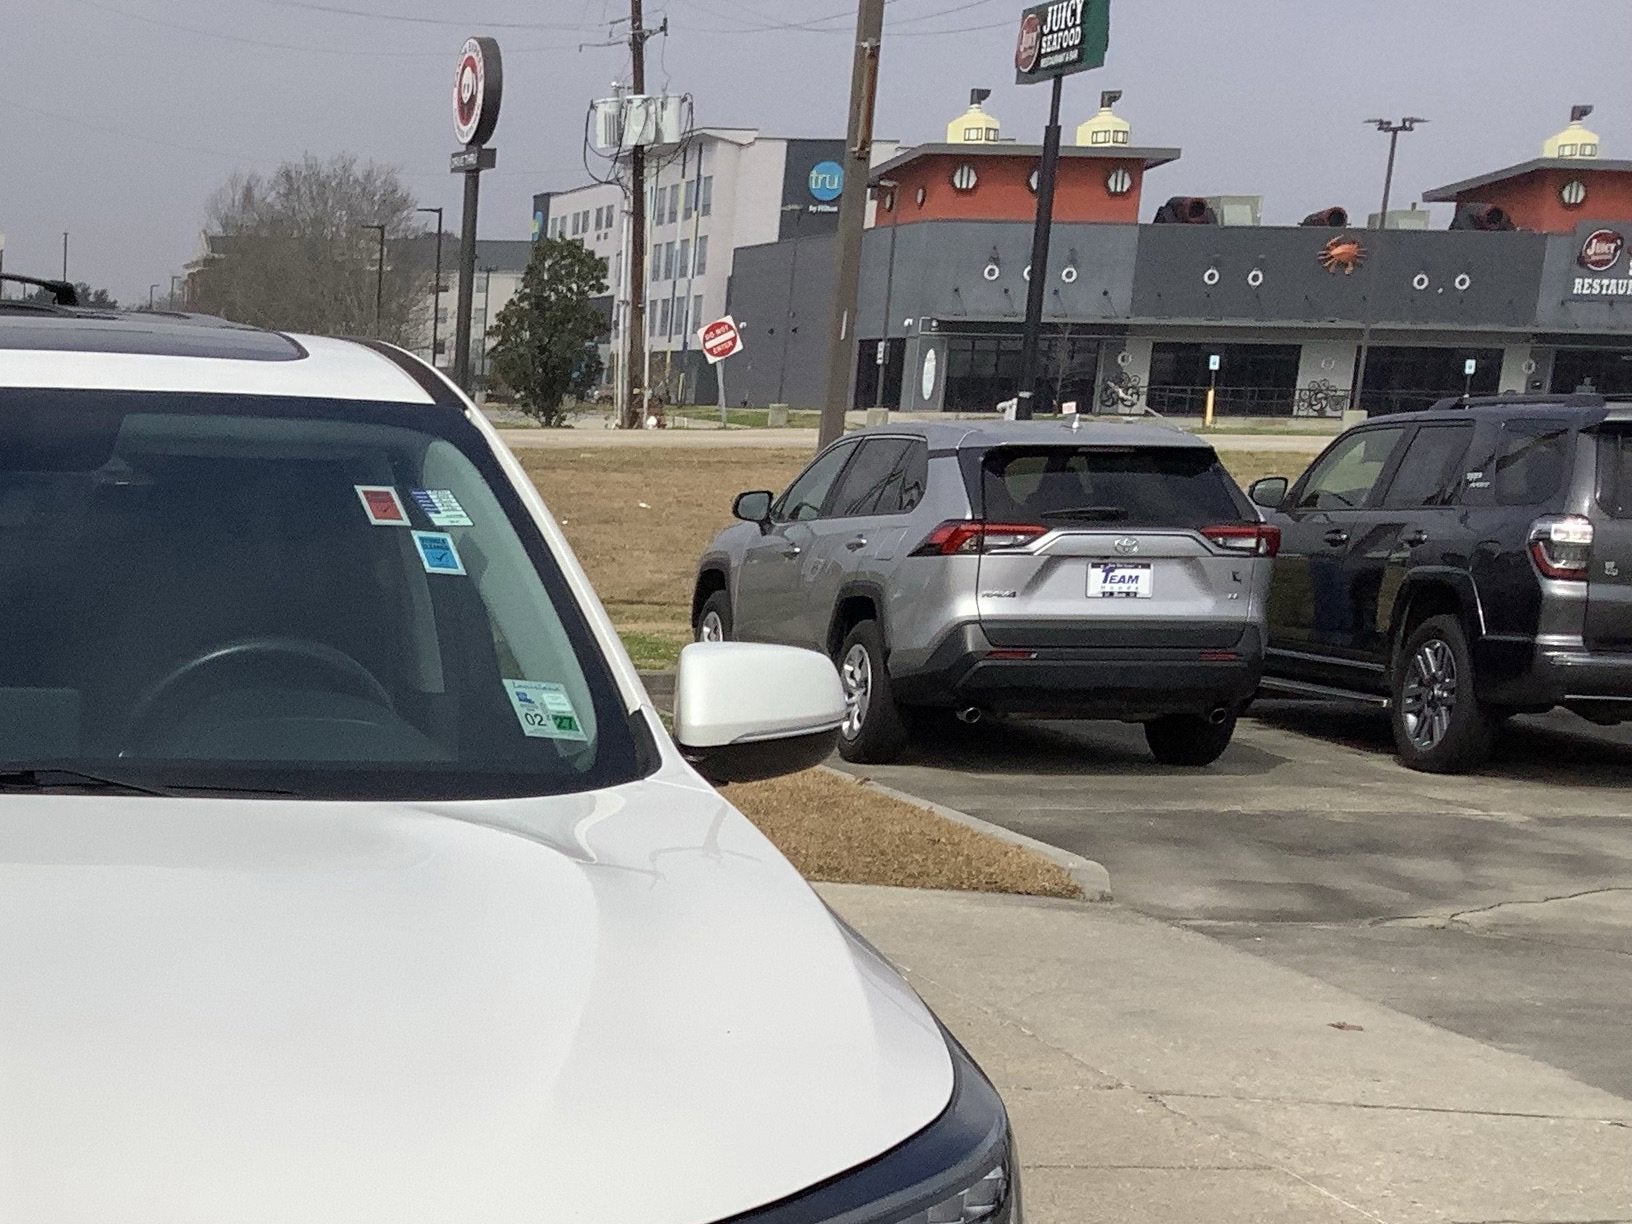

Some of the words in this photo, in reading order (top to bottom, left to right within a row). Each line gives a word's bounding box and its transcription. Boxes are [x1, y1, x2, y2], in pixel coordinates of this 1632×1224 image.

[1042, 0, 1084, 34] JUICY
[1040, 26, 1082, 54] SEAFOOD
[810, 169, 839, 189] tru
[715, 324, 729, 335] NOT
[712, 340, 734, 355] ENTER
[525, 713, 547, 726] 02
[553, 715, 578, 731] 27
